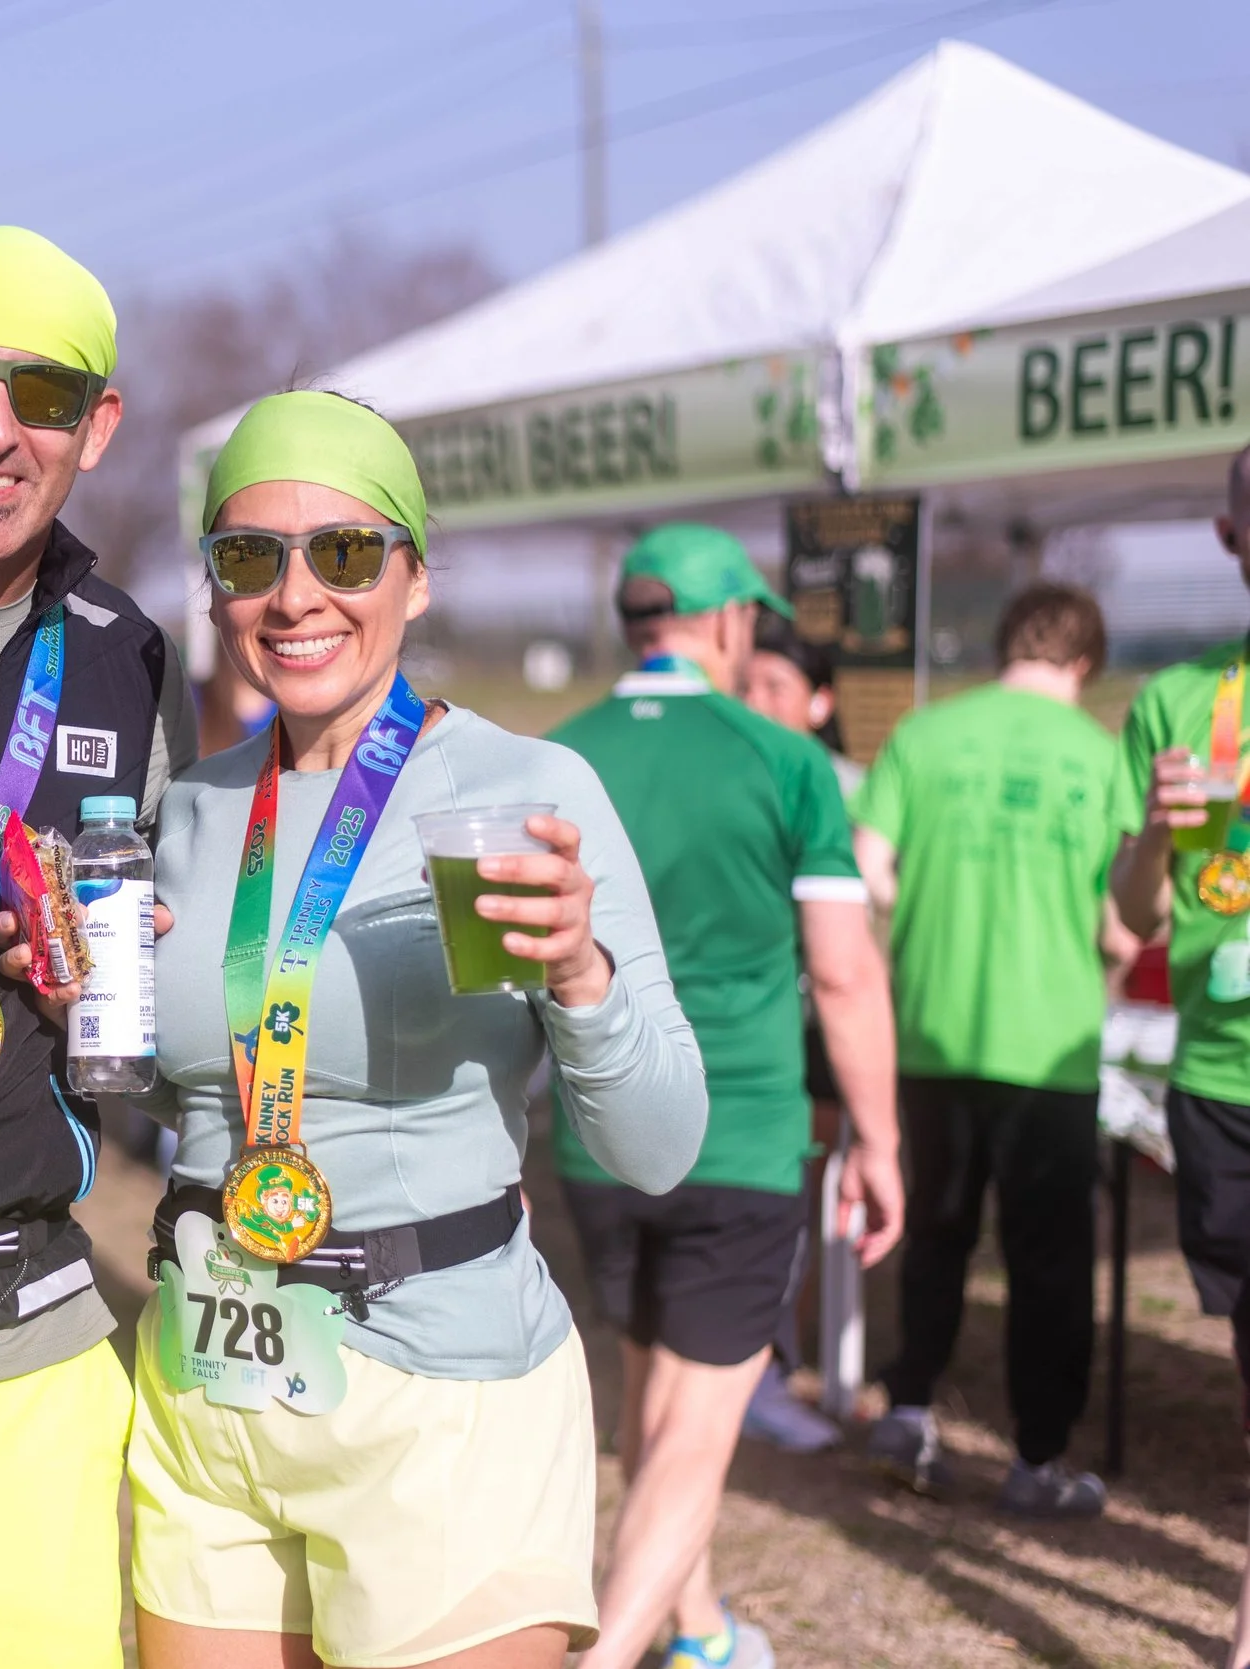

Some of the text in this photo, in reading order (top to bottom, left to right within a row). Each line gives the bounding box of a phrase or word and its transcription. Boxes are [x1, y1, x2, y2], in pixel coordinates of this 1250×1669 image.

[1019, 318, 1235, 442] BEER!
[410, 390, 680, 506] EER! BEER!
[10, 679, 57, 770] BFT
[71, 739, 107, 763] HC RUN
[357, 696, 419, 776] BFT
[247, 816, 268, 877] 2025
[324, 806, 366, 867] 2025
[88, 930, 116, 938] nature
[289, 879, 322, 943] TRINITY
[303, 898, 332, 945] FALLS
[79, 992, 117, 1002] evamor
[275, 1010, 290, 1032] 5K
[255, 1080, 276, 1144] KINNEY
[277, 1068, 295, 1103] RUN
[297, 1197, 316, 1211] 5K
[187, 1292, 284, 1366] 728
[191, 1357, 227, 1371] TRINITY
[192, 1367, 220, 1380] FALLS
